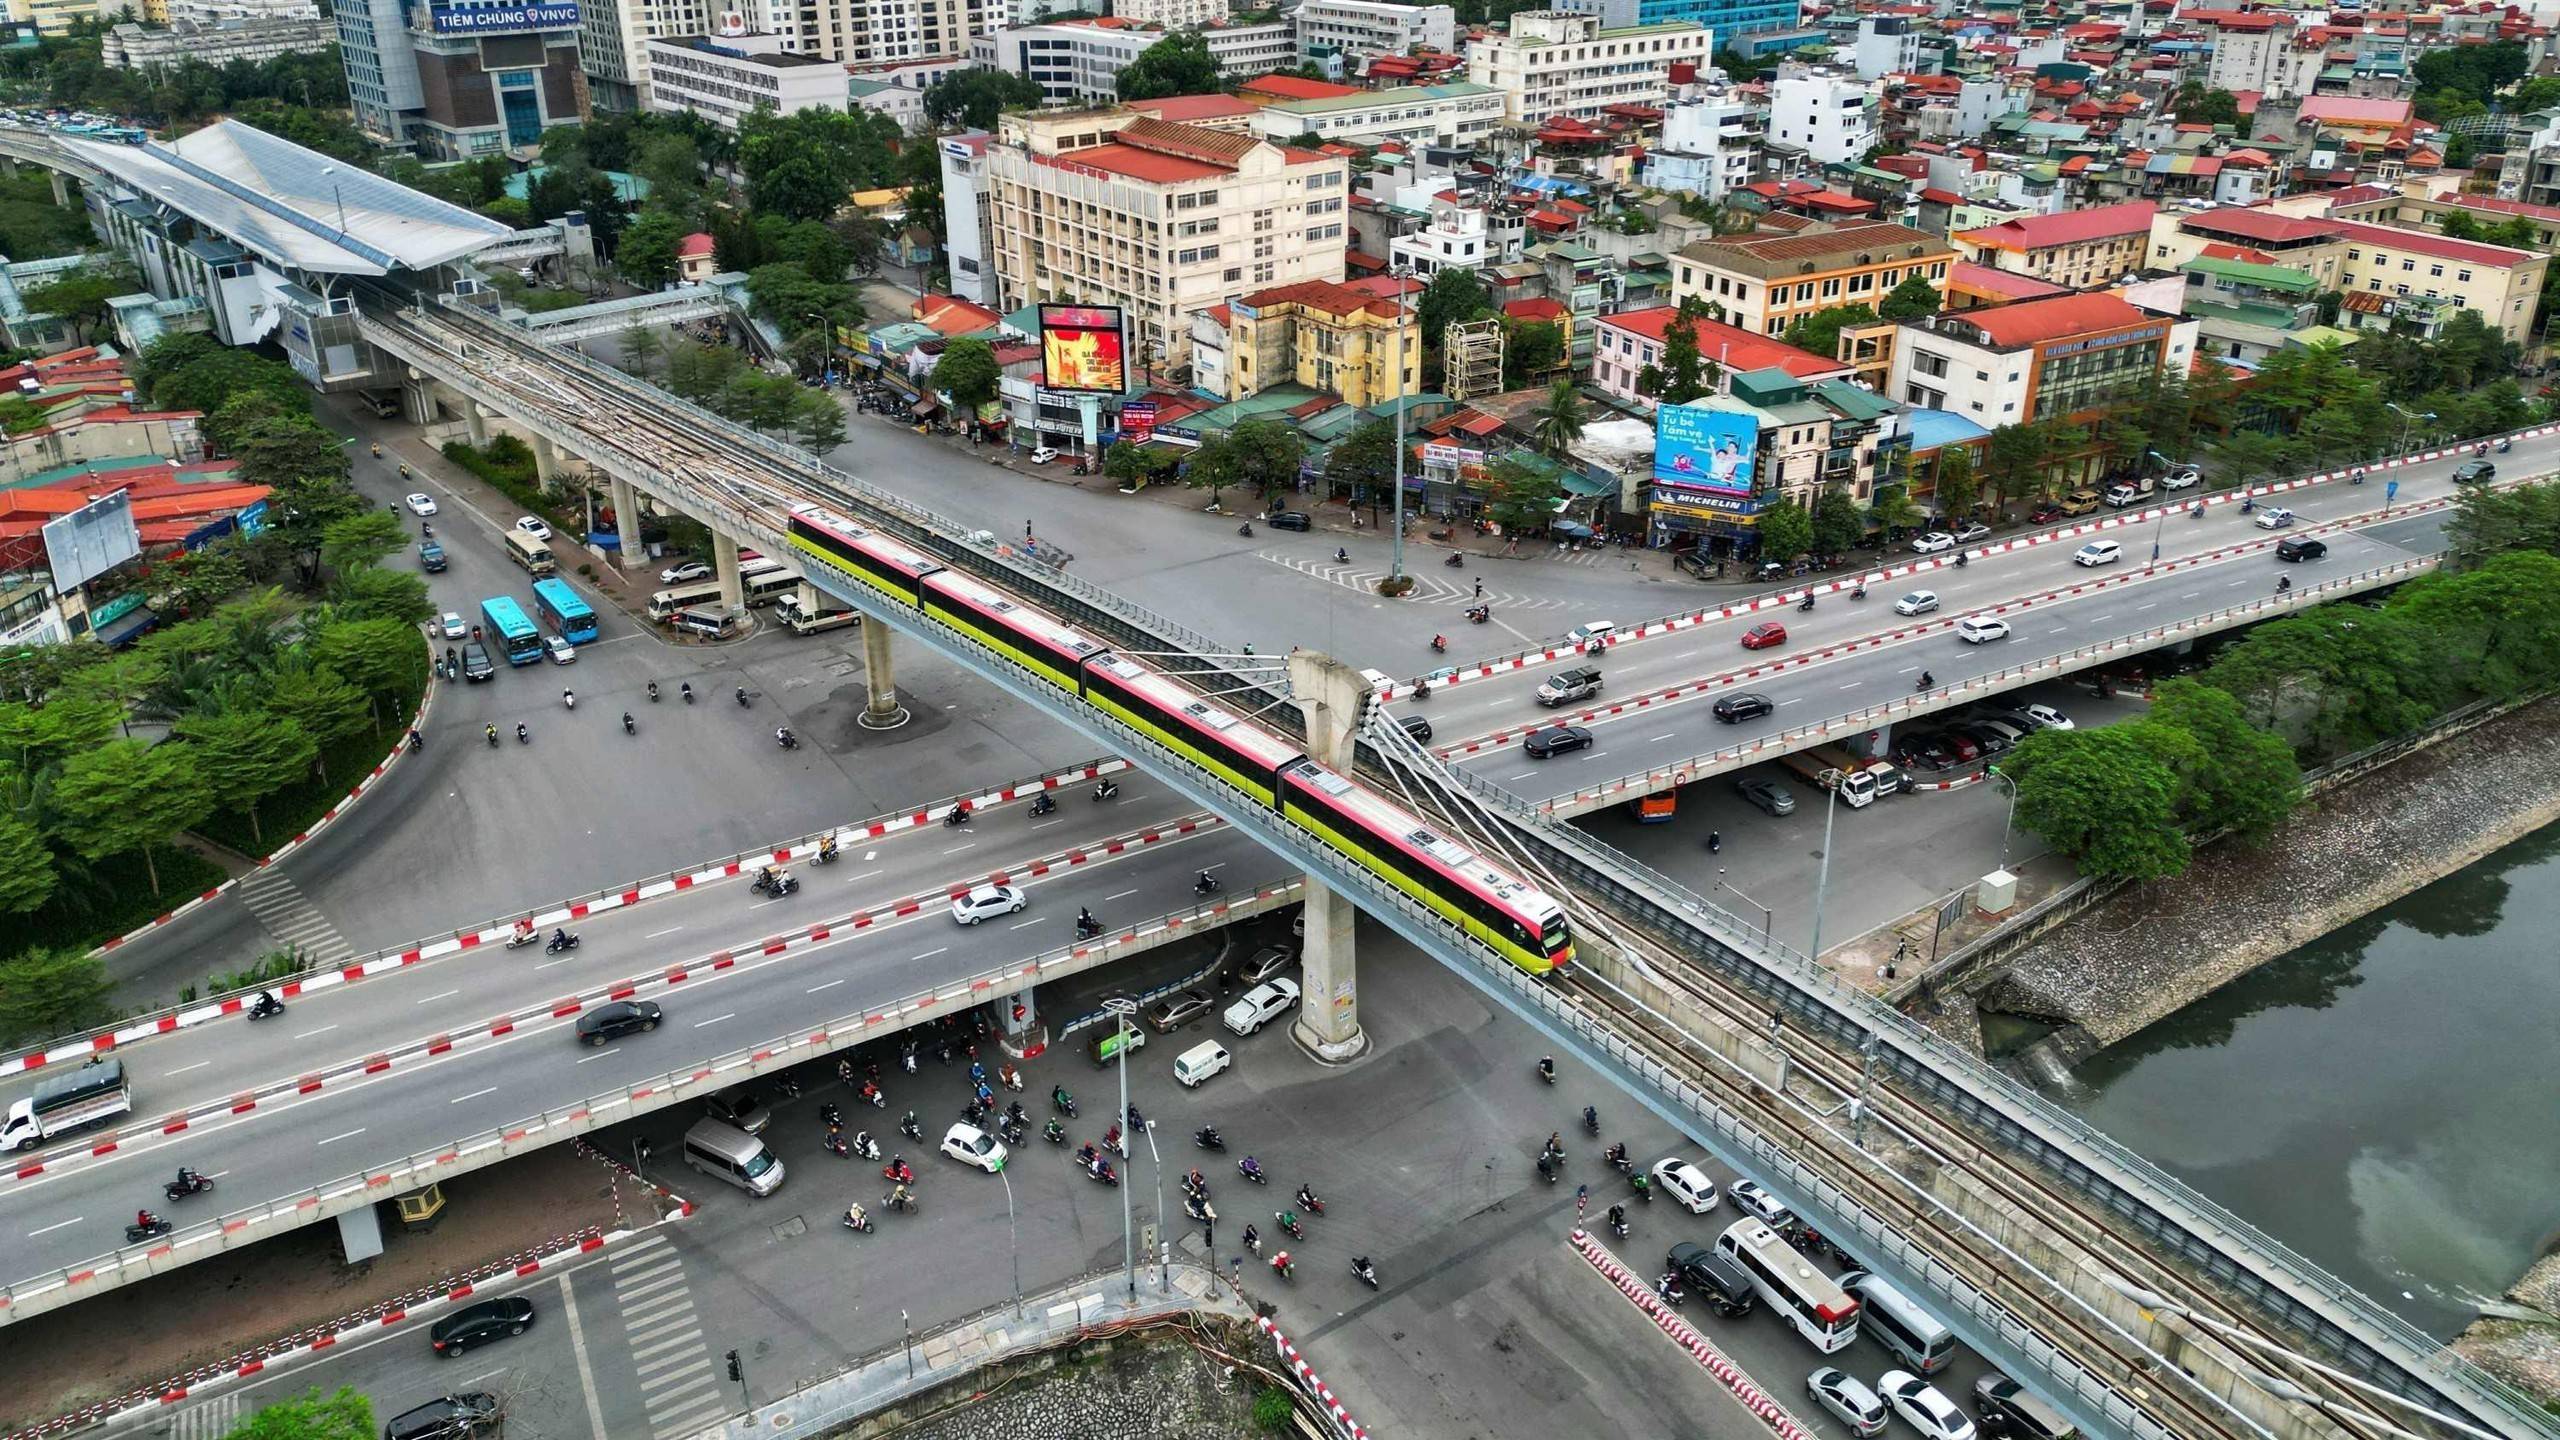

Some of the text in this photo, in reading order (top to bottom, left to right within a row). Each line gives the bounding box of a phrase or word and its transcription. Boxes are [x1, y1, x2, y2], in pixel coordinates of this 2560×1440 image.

[439, 13, 474, 28] TIÊM
[539, 8, 576, 21] VNVC
[1677, 494, 1740, 510] MICHELIN
